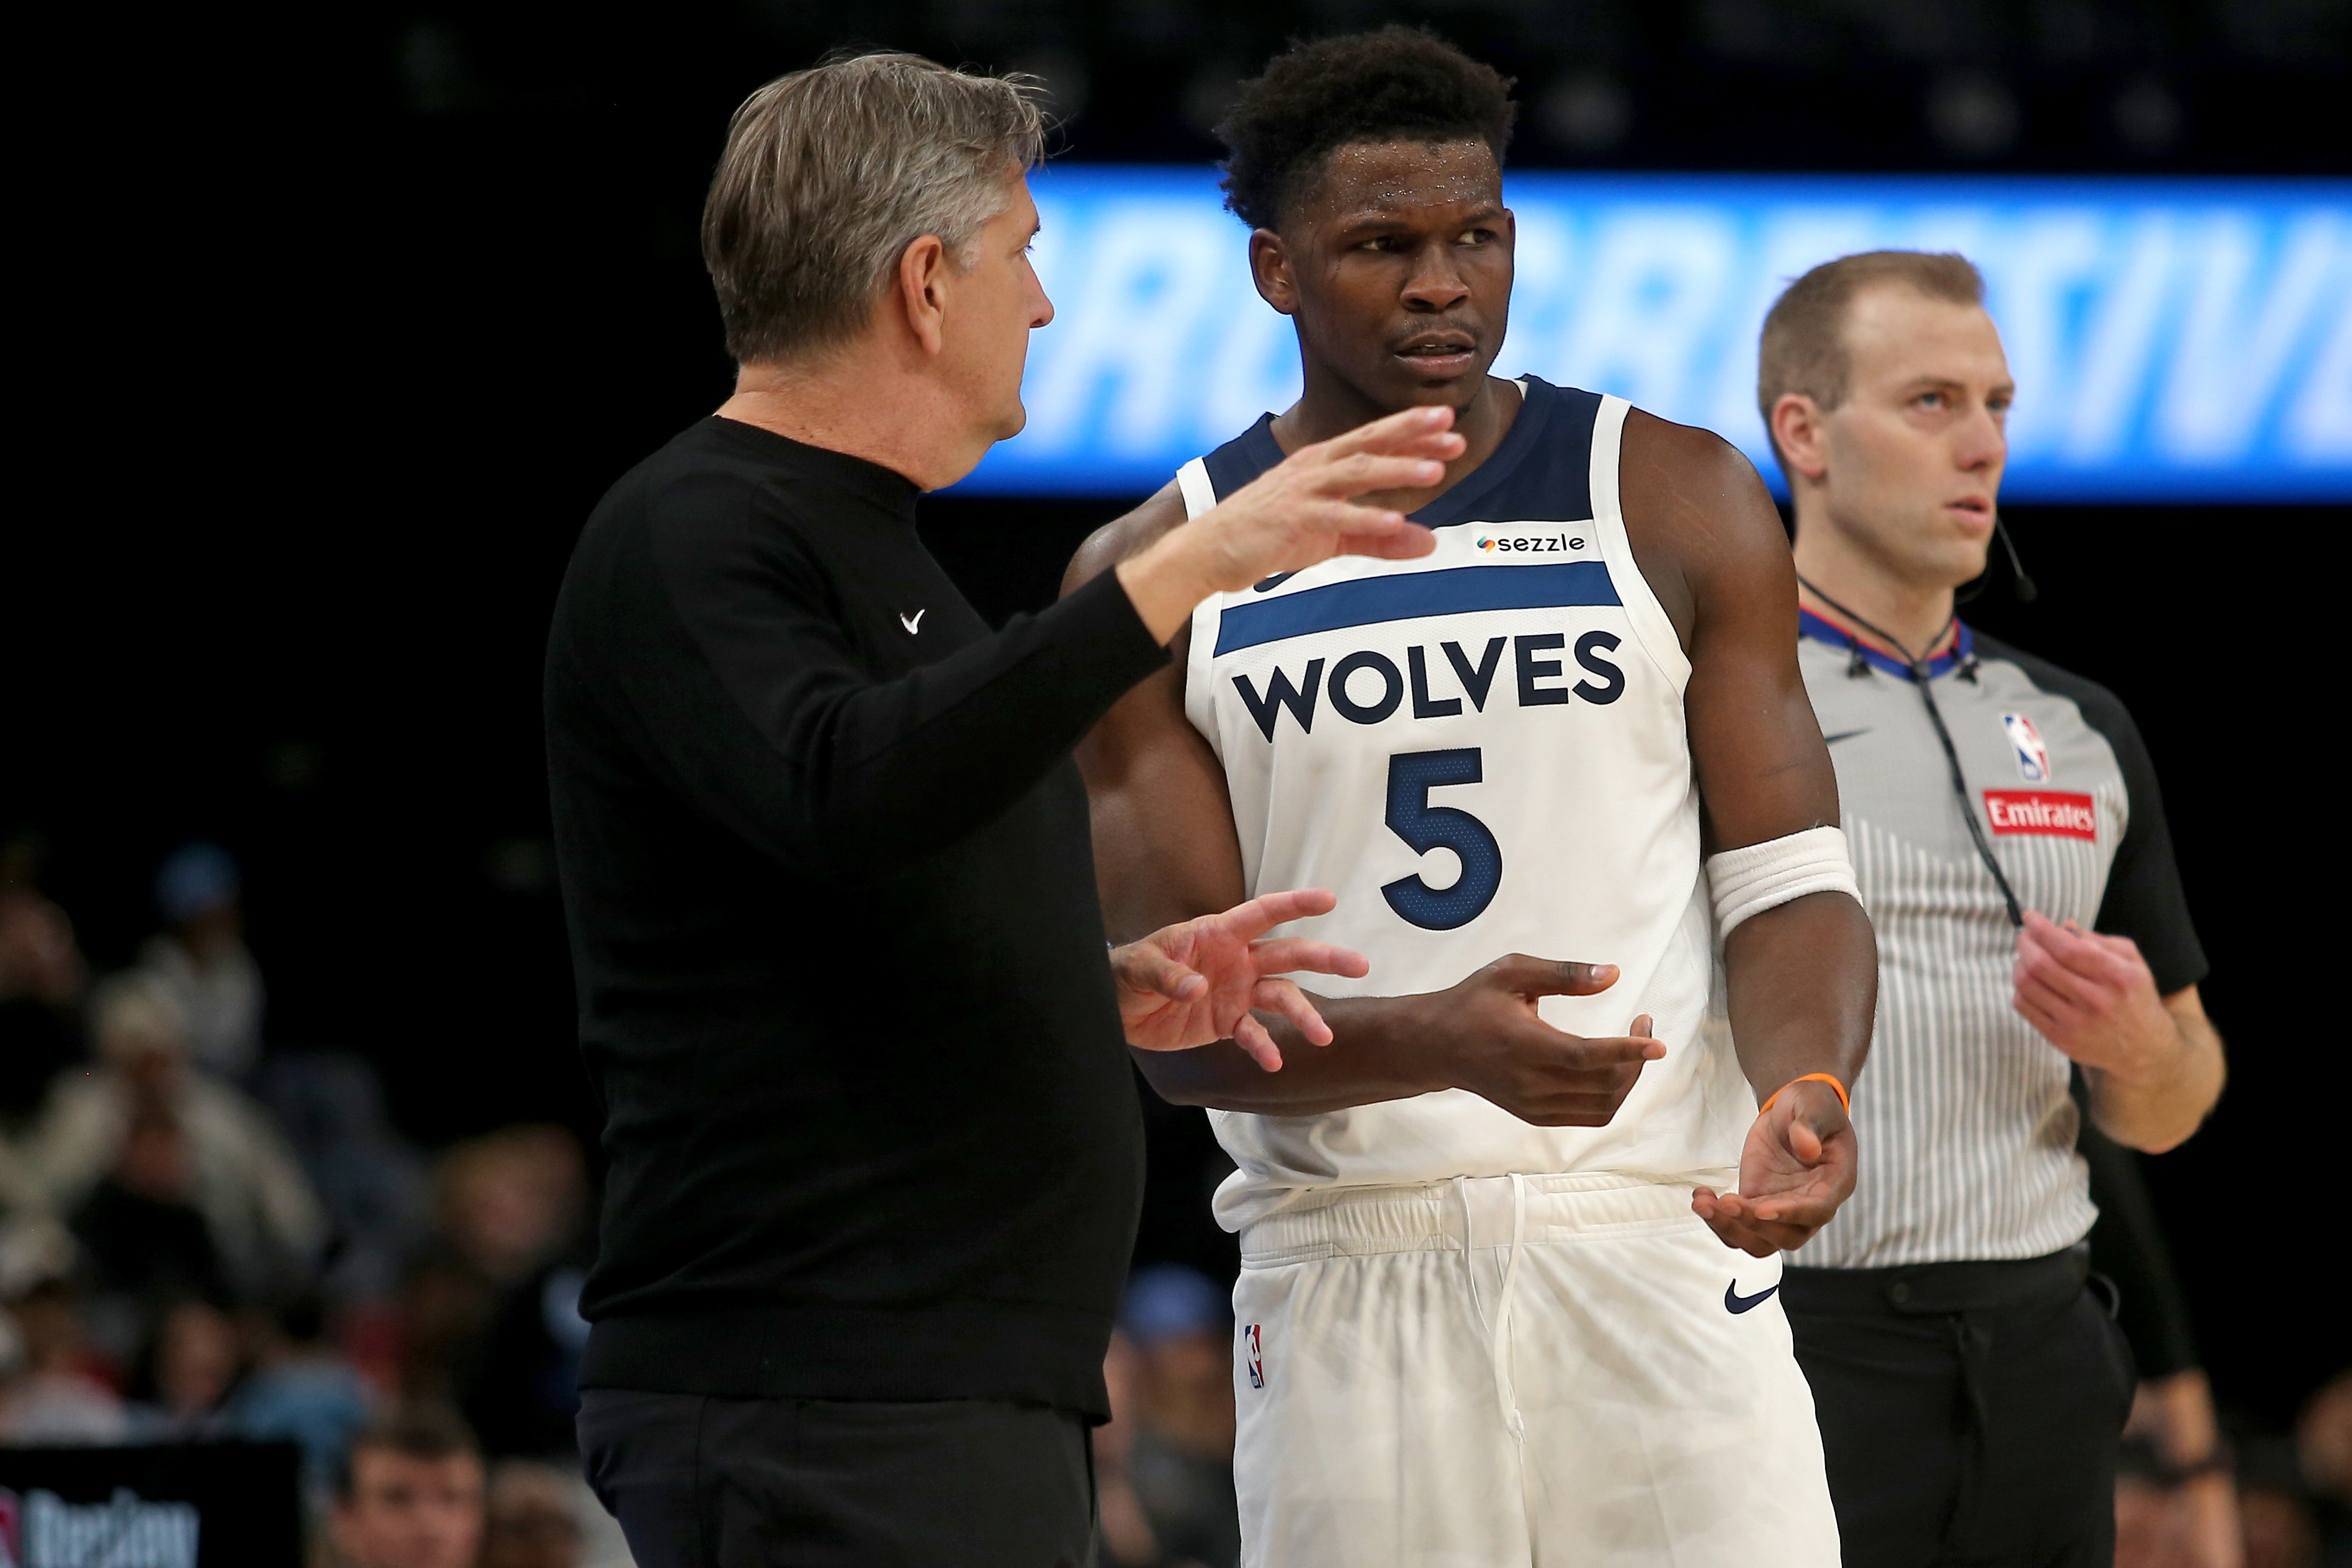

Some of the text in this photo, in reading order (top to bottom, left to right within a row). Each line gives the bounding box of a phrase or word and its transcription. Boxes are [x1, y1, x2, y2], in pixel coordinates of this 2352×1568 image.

[1497, 533, 1585, 552] sezzle
[1231, 630, 1625, 743] WOLVES
[1380, 747, 1502, 931] 5
[1987, 797, 2095, 832] Emirates
